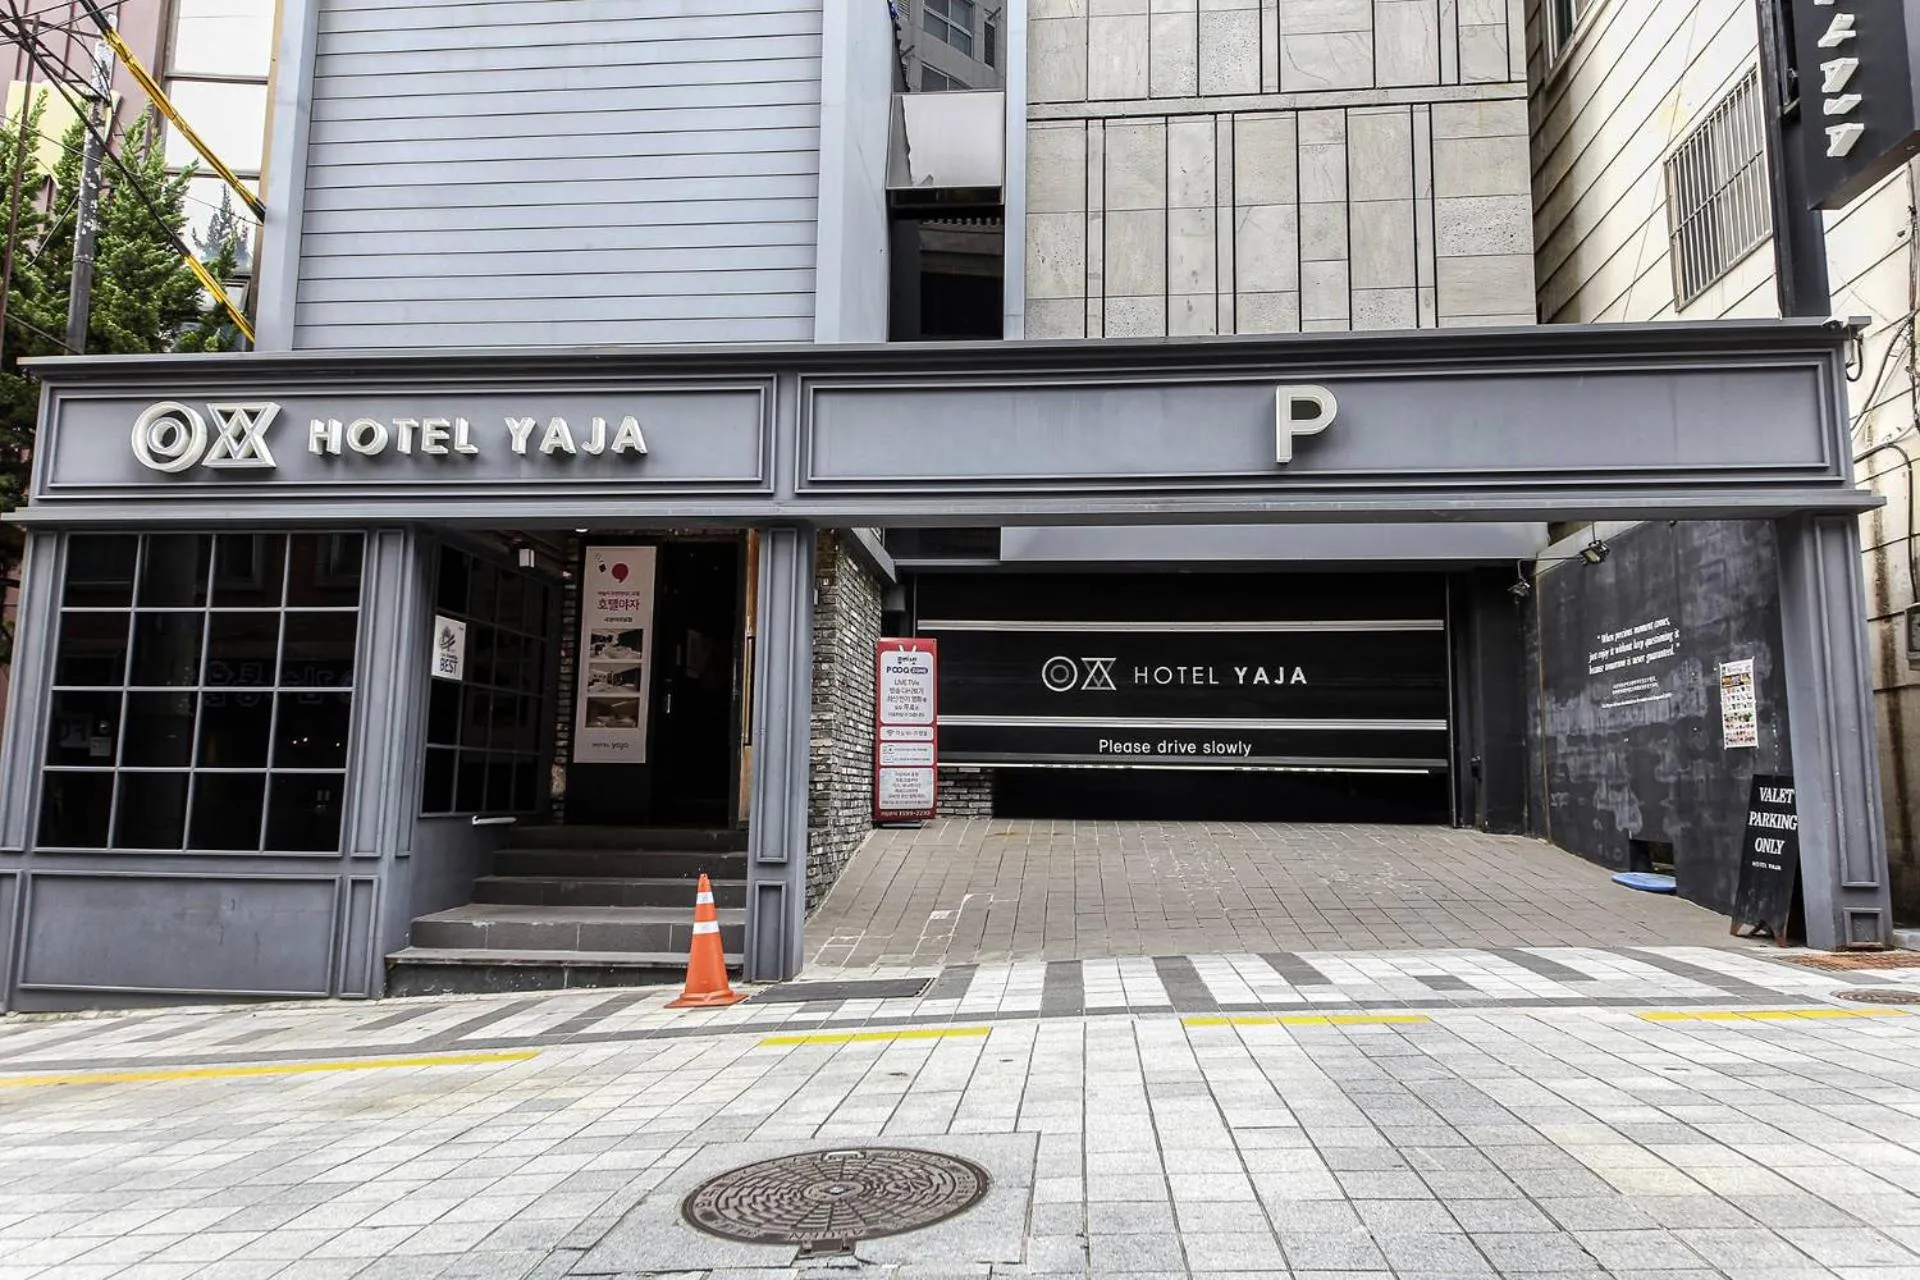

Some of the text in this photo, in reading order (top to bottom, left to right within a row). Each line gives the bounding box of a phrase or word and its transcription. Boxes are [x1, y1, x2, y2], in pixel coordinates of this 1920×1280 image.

[1275, 384, 1338, 463] P
[308, 414, 649, 456] HOTEL YAJA
[1134, 666, 1308, 685] HOTEL YAJA
[1098, 739, 1252, 757] Please drive slowly
[1759, 787, 1795, 803] VALET
[1748, 811, 1798, 831] PARKING
[1754, 837, 1785, 854] ONLY
